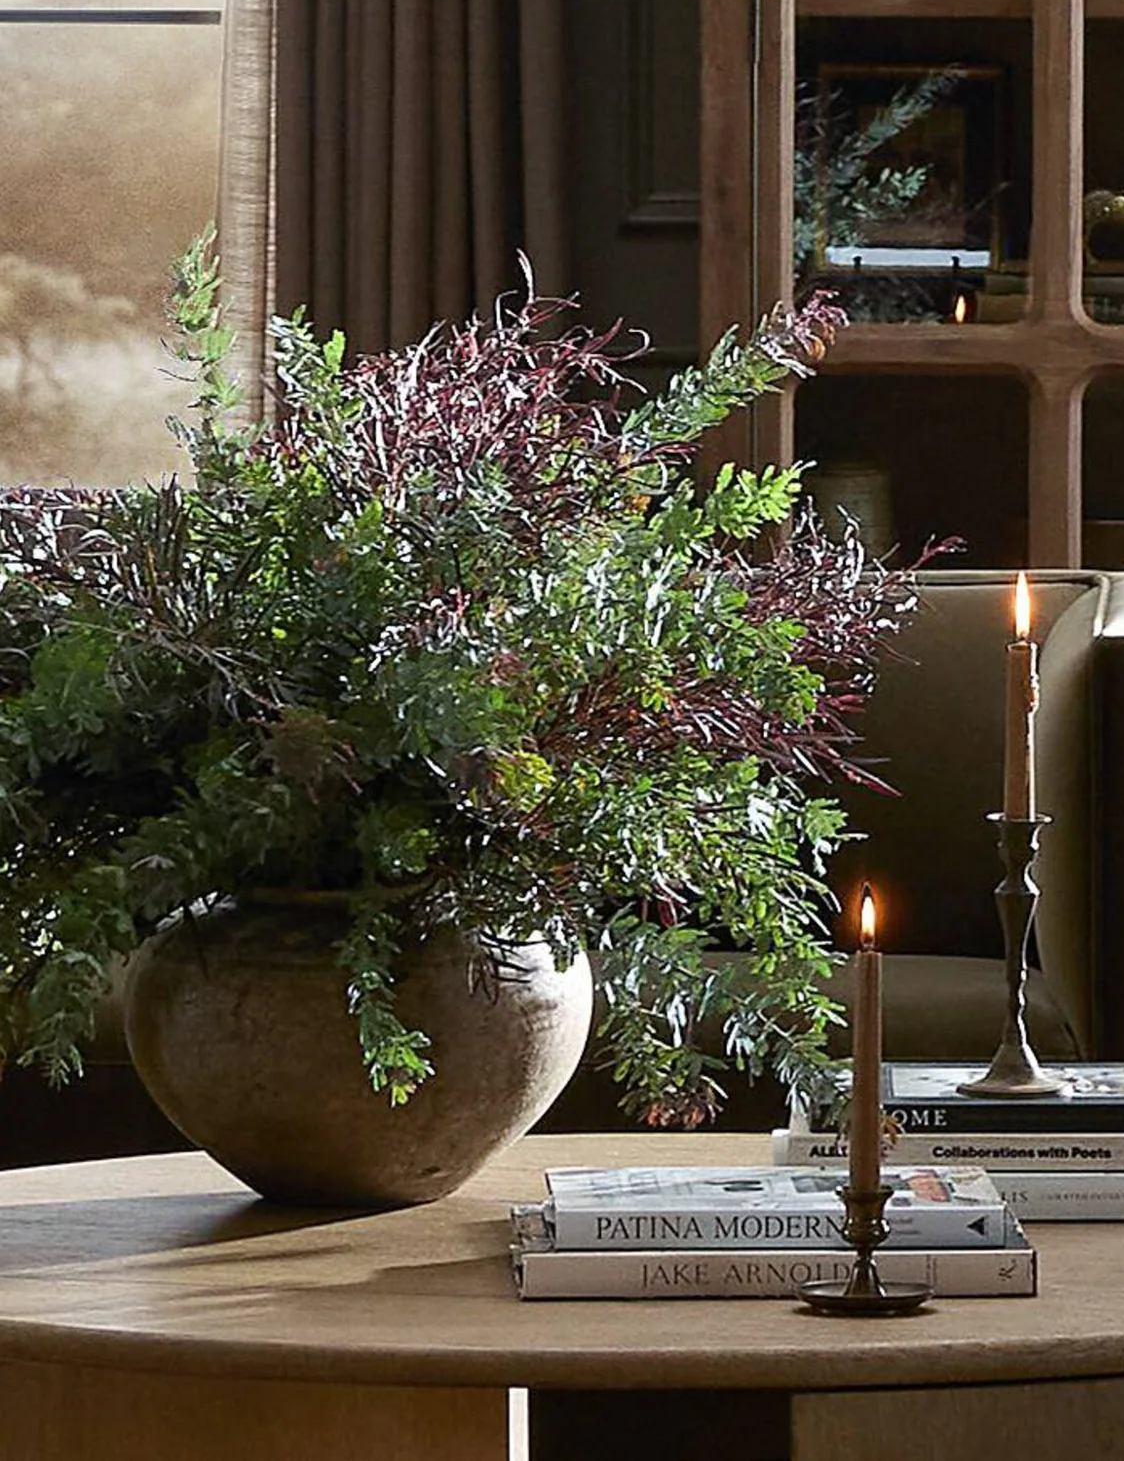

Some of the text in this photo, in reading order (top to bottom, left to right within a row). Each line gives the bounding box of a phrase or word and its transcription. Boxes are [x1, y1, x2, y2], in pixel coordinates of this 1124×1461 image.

[882, 1109, 948, 1127] OME
[932, 1146, 1112, 1159] Collaborations with Poets
[1001, 1191, 1028, 1204] LIS
[596, 1215, 845, 1239] PATINA MODERN
[641, 1261, 852, 1288] JAKE ARNOLD
